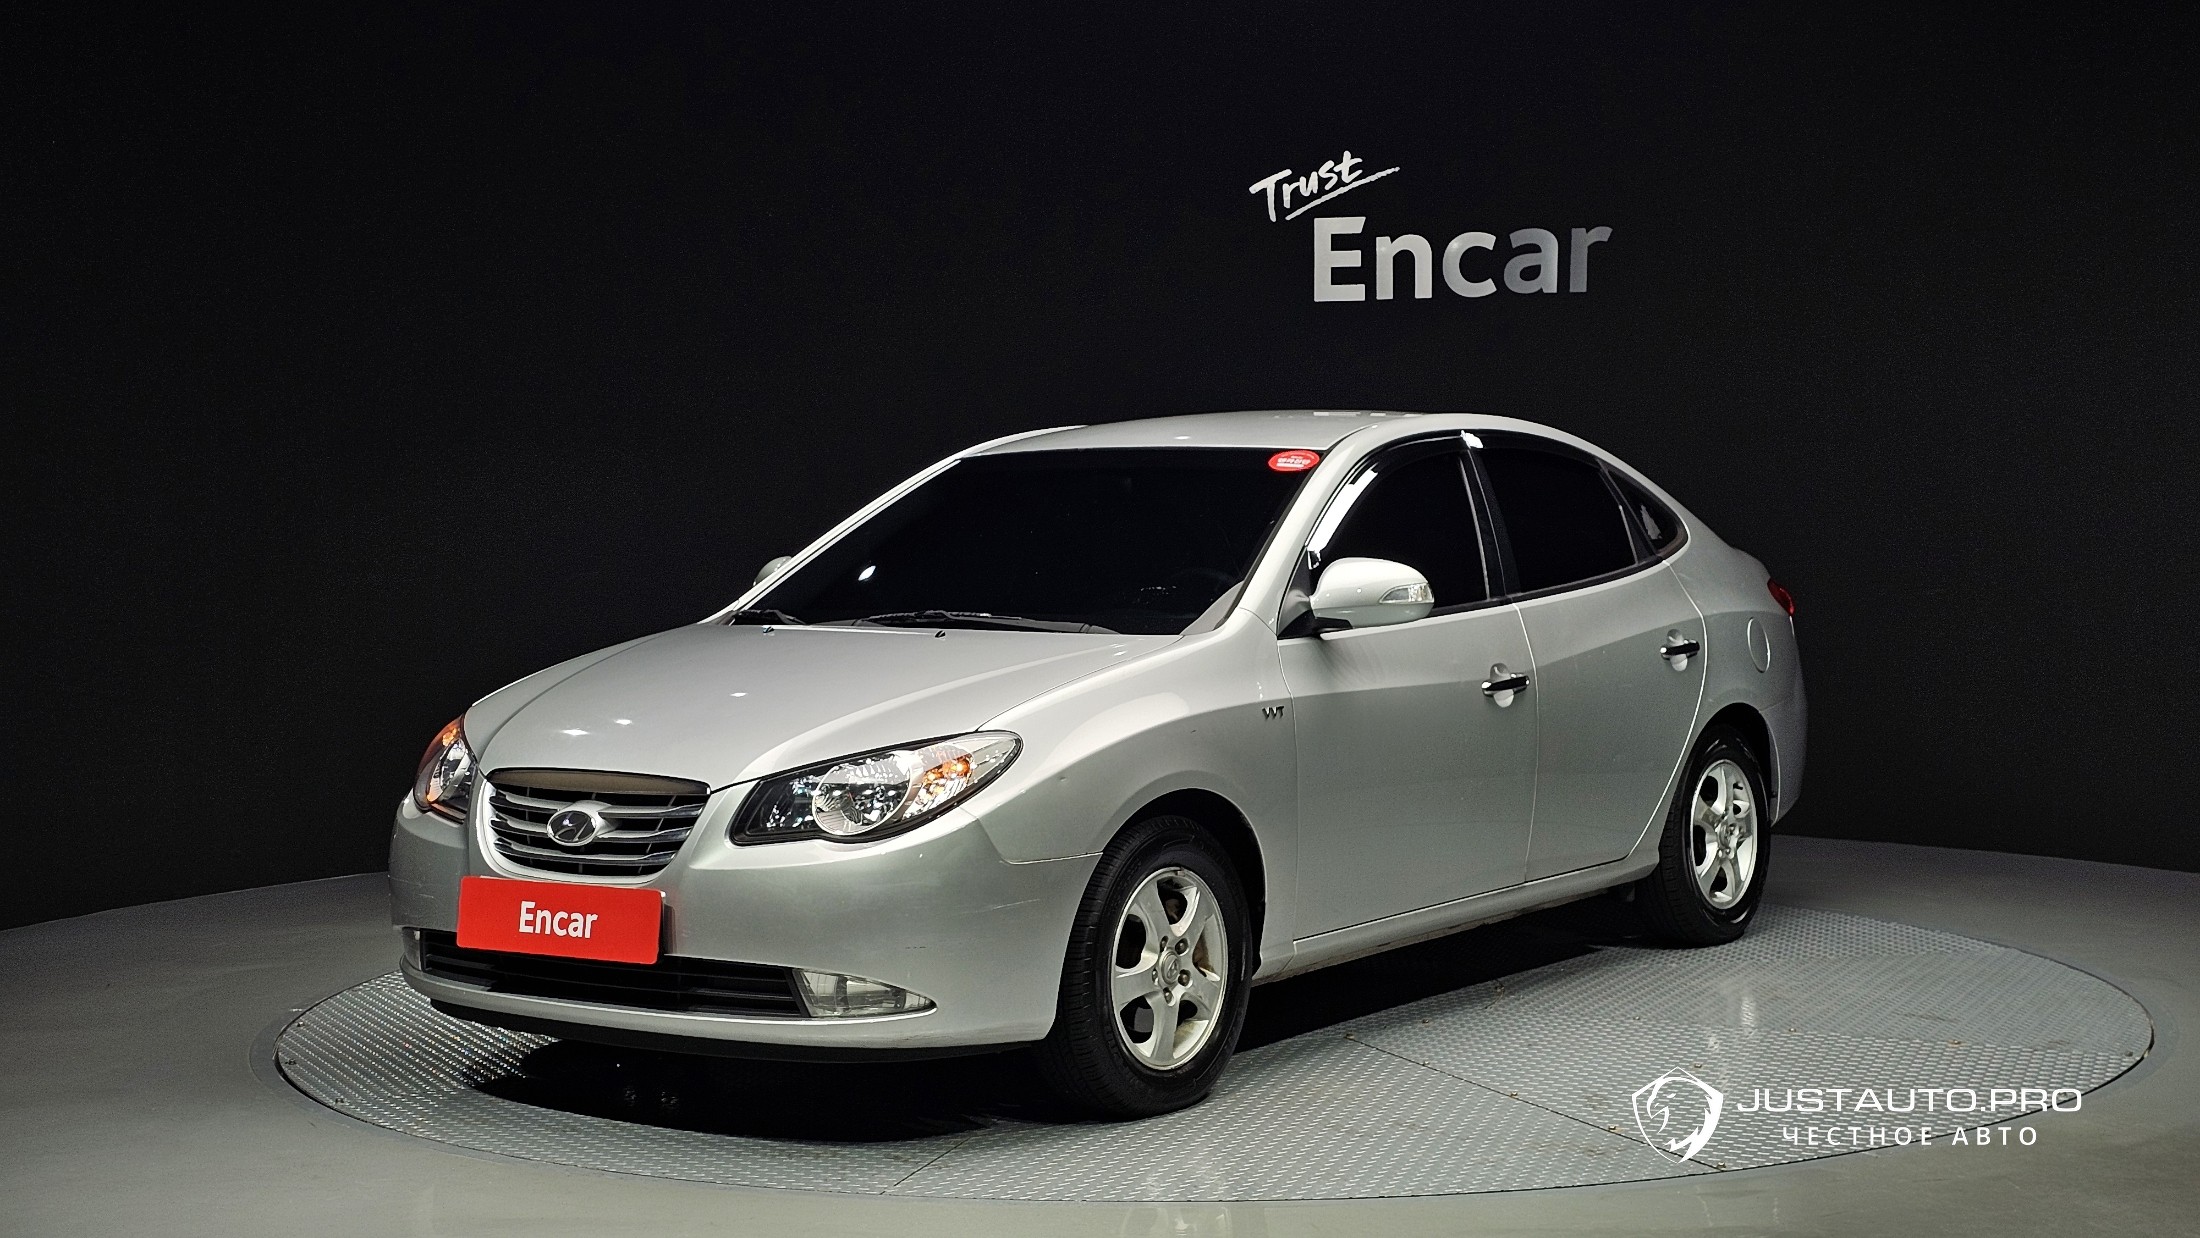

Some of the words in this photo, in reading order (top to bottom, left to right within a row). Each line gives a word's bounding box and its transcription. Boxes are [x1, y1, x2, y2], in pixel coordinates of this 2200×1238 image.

[1249, 151, 1363, 222] Trust
[1314, 216, 1613, 302] Encar
[519, 900, 598, 939] Encar
